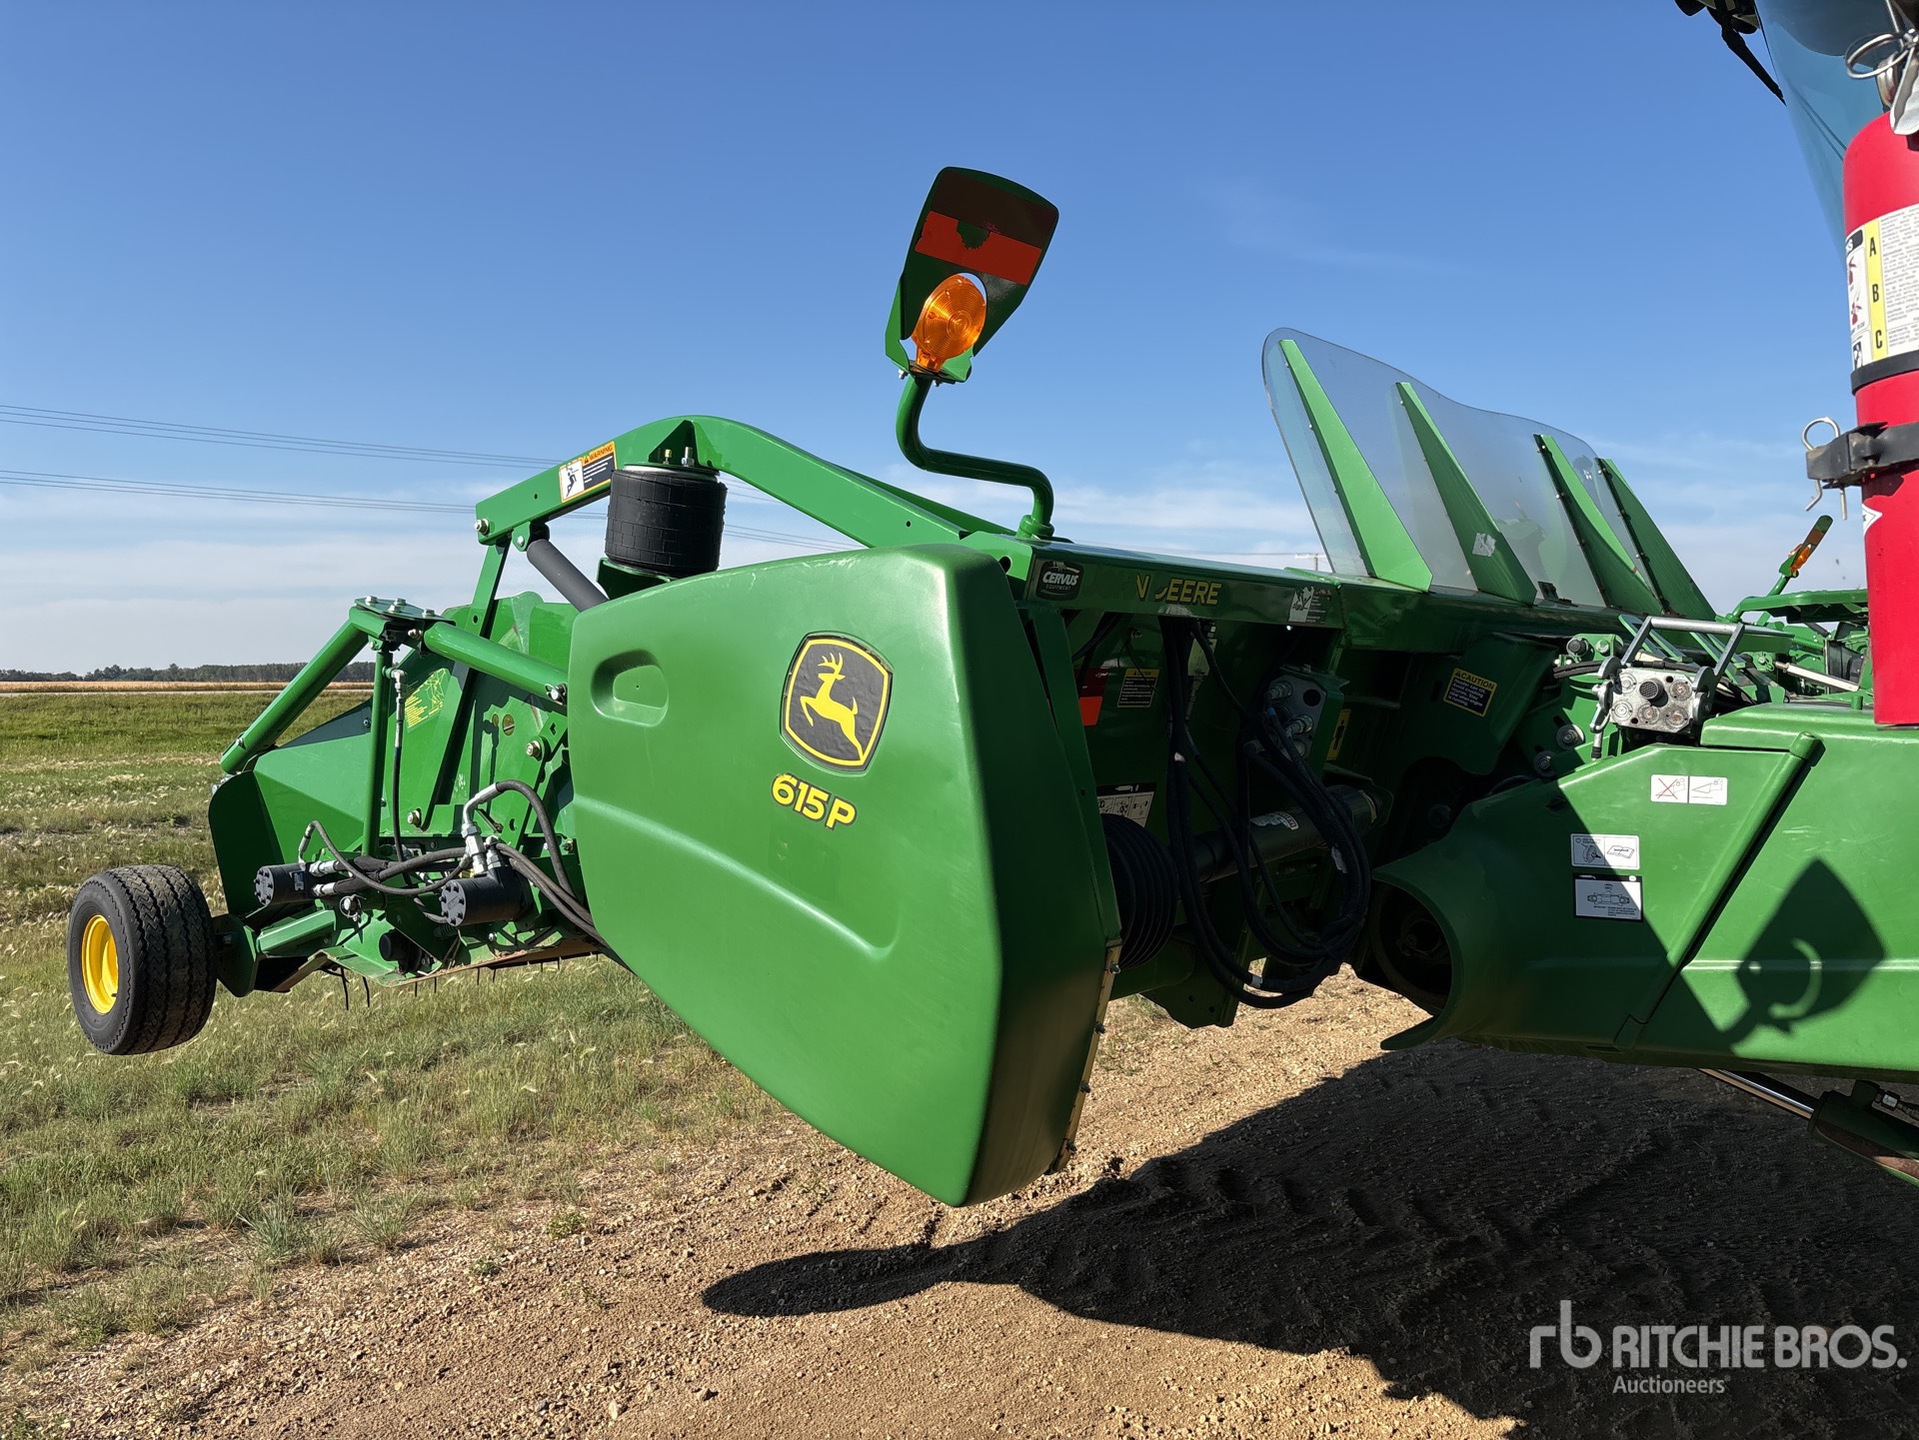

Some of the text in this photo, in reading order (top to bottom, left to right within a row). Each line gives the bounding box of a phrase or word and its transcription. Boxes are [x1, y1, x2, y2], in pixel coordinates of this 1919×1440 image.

[1869, 237, 1877, 257] A
[1872, 283, 1880, 303] B
[1875, 329, 1883, 350] C
[1042, 571, 1079, 586] CERVUS
[1155, 578, 1222, 605] EERE
[1461, 672, 1494, 690] CAUTION
[771, 772, 857, 830] 615P
